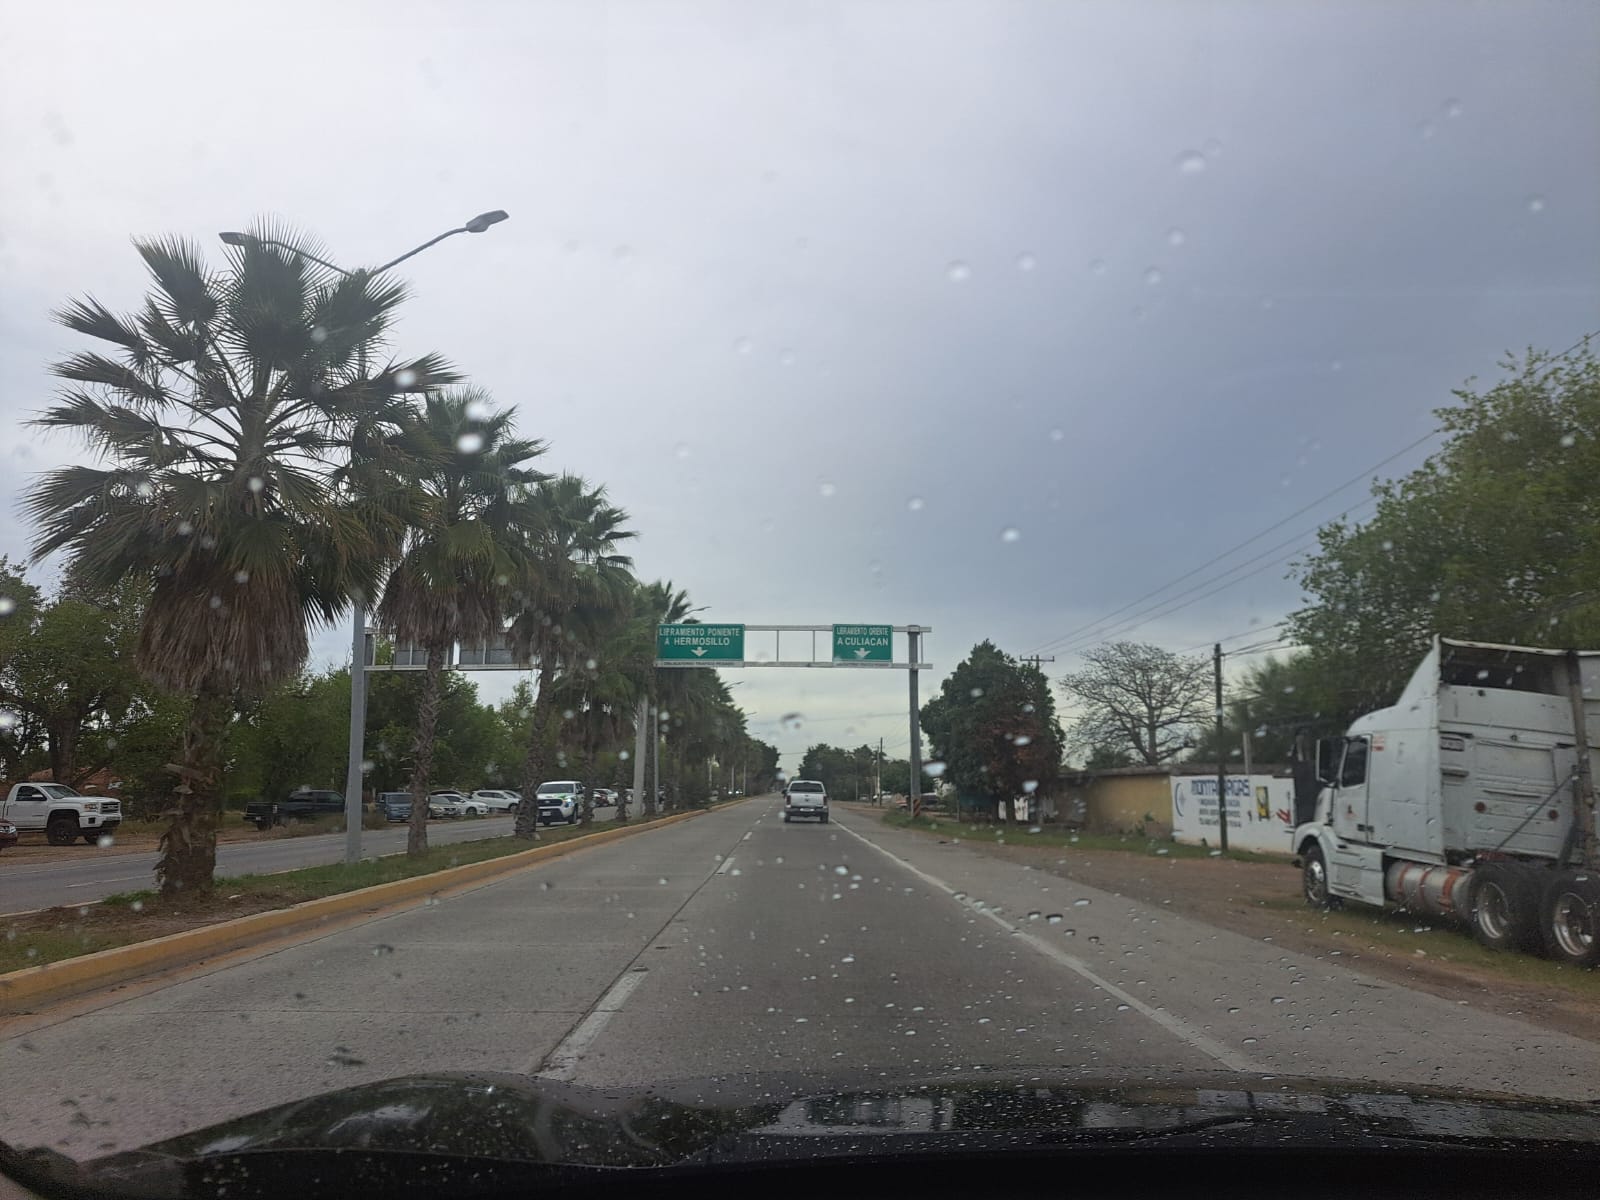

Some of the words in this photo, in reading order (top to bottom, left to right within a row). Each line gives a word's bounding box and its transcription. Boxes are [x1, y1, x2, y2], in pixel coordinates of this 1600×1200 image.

[659, 628, 705, 636] LIBRAMIENTO
[708, 628, 741, 636] PONIENTE
[664, 637, 670, 645] A
[673, 637, 730, 646] HERMOSILLO
[837, 637, 844, 646] A
[845, 637, 889, 647] CULIACAN
